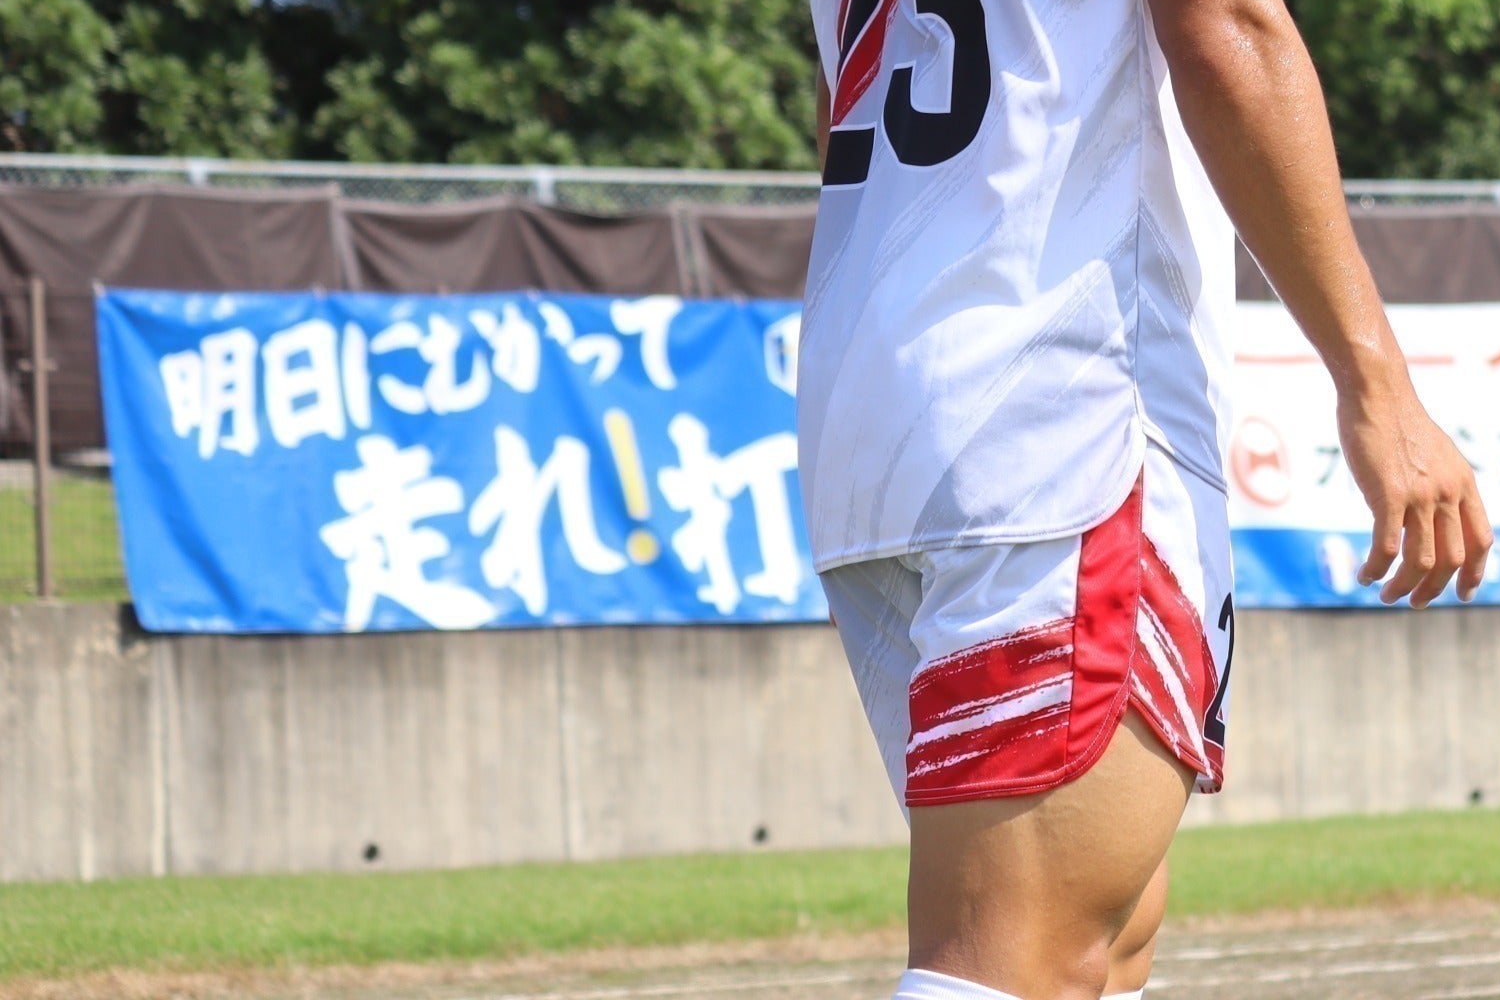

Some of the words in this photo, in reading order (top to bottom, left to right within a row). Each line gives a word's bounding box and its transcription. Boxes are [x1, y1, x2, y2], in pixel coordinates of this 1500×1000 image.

[160, 296, 681, 459] 明日にむかって
